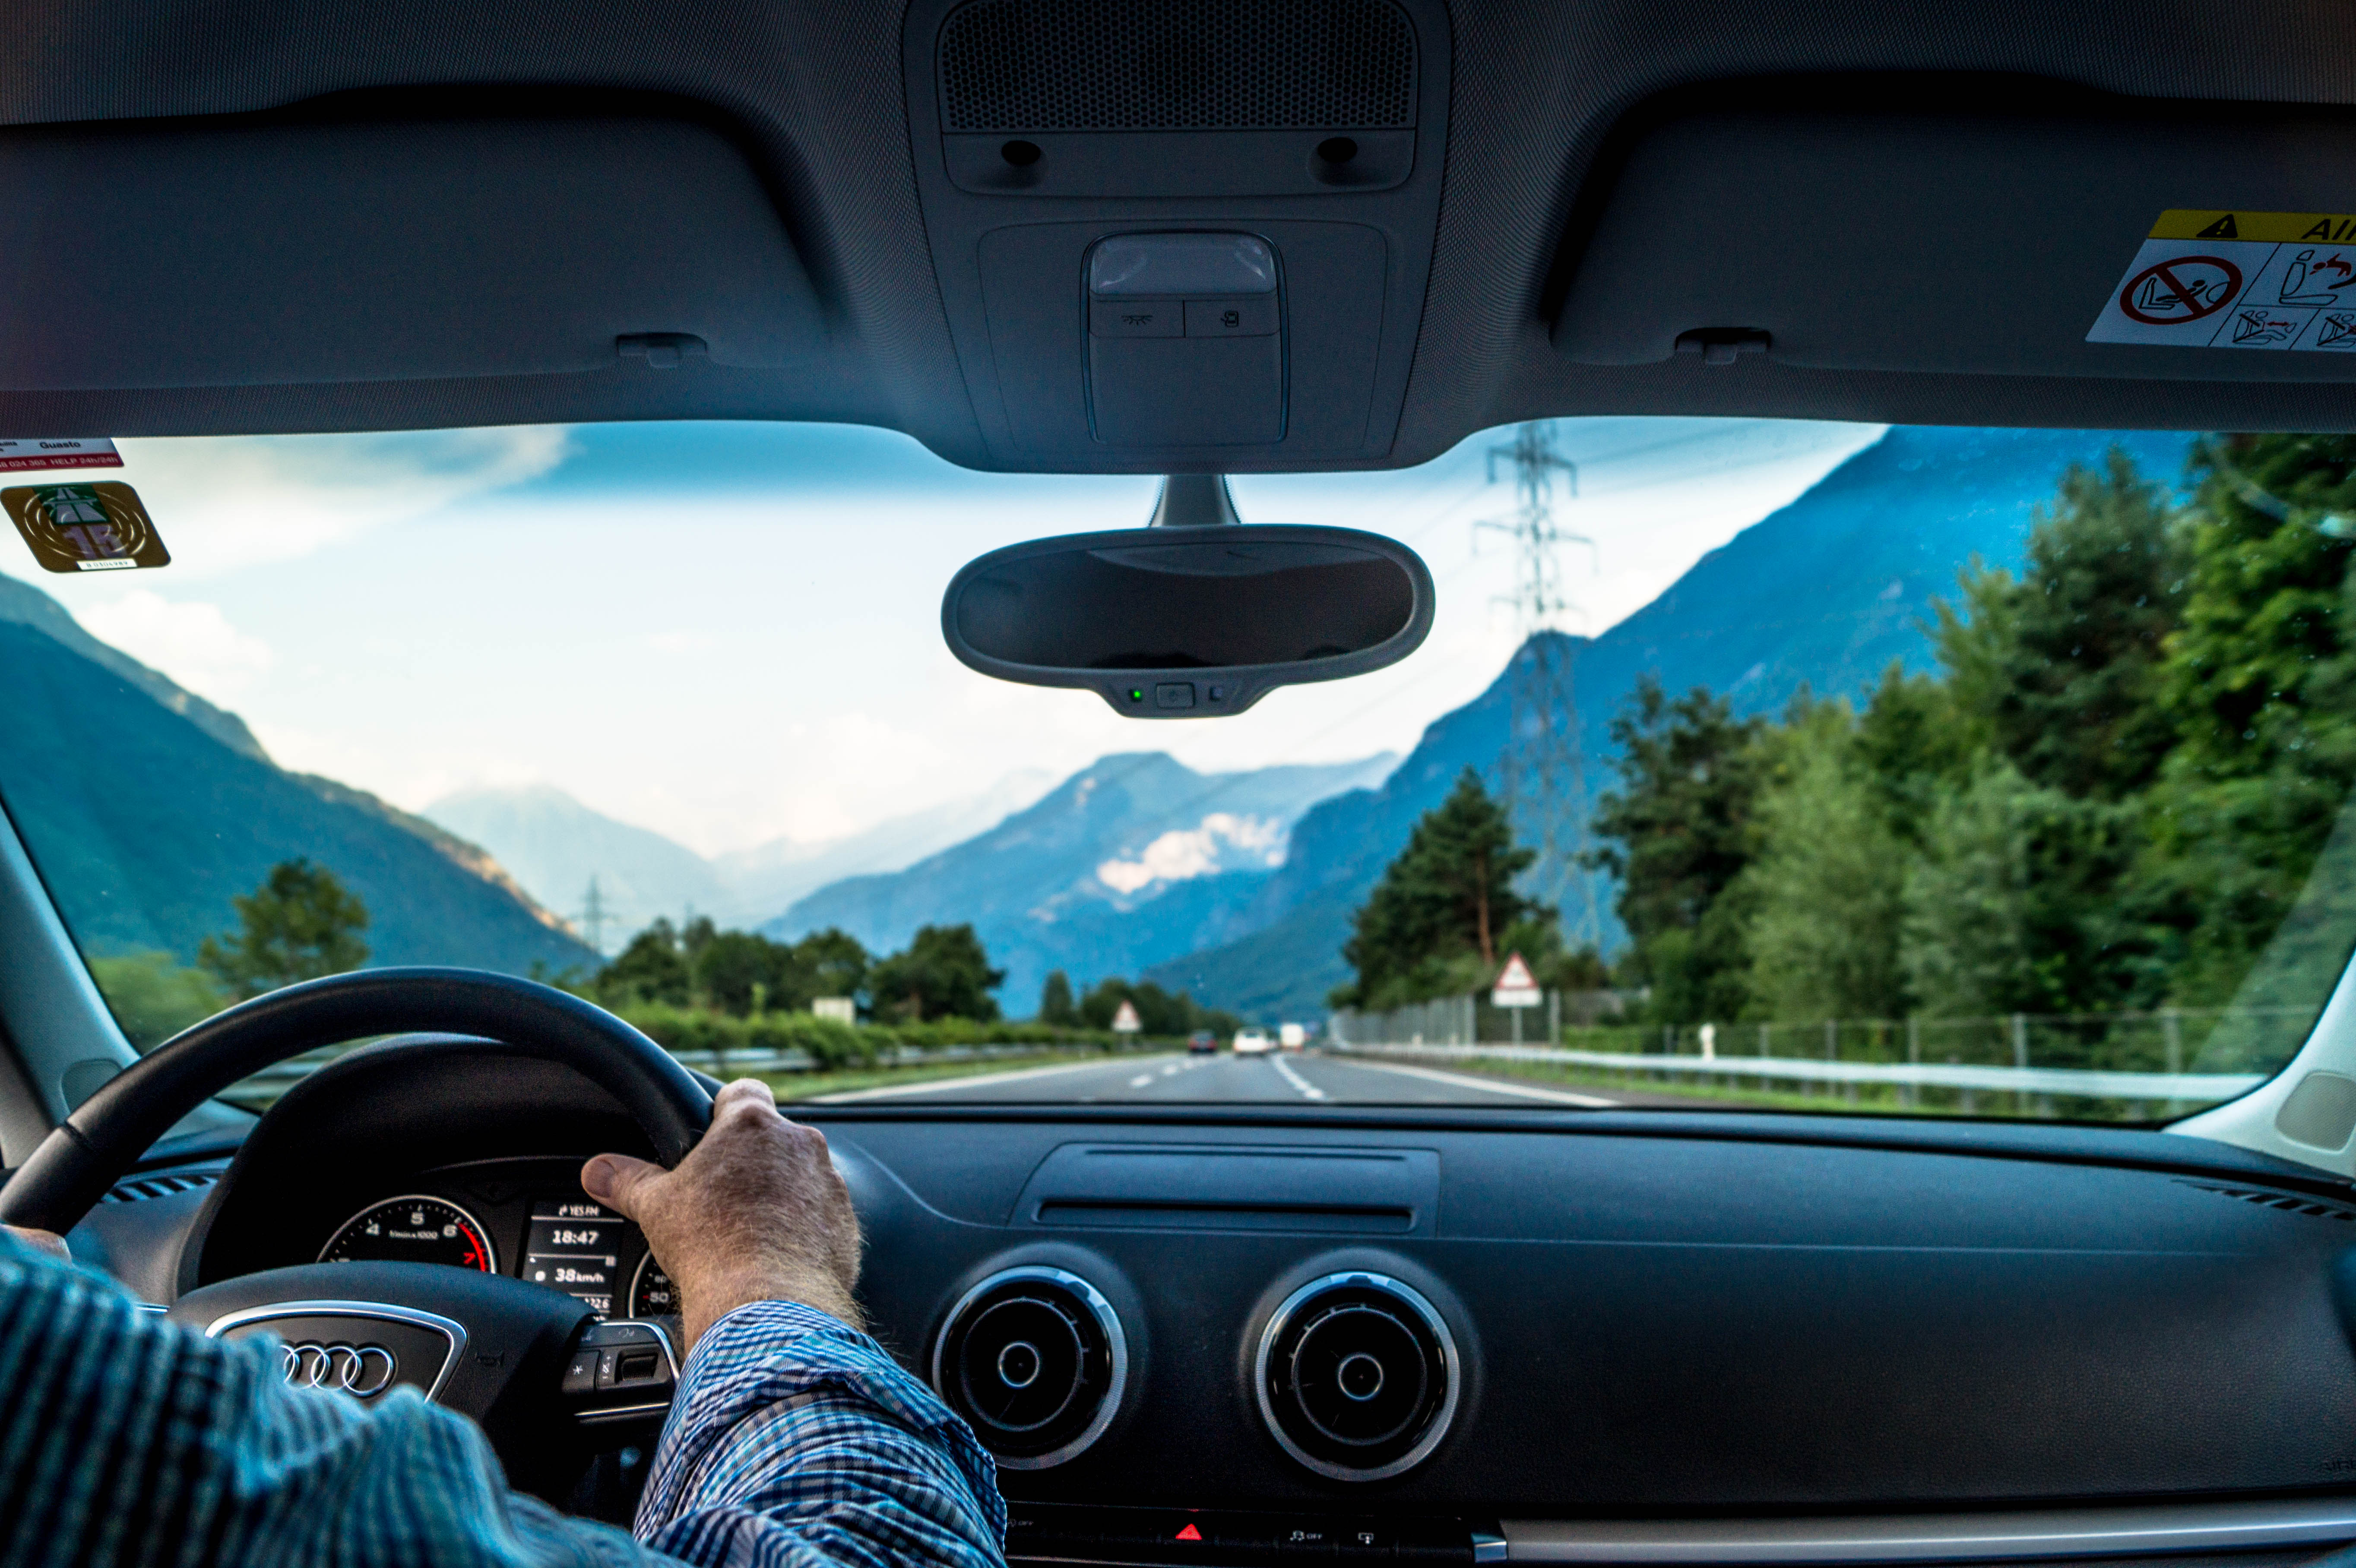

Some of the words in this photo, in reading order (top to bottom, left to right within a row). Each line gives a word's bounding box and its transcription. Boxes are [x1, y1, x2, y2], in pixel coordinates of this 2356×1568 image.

[79, 456, 118, 464] 24h/24h
[62, 525, 127, 560] 15
[411, 1211, 424, 1225] 5
[365, 1223, 380, 1236] 4
[443, 1223, 457, 1238] 6
[553, 1230, 599, 1245] 18:47
[463, 1252, 475, 1264] 7
[649, 1291, 669, 1303] 50
